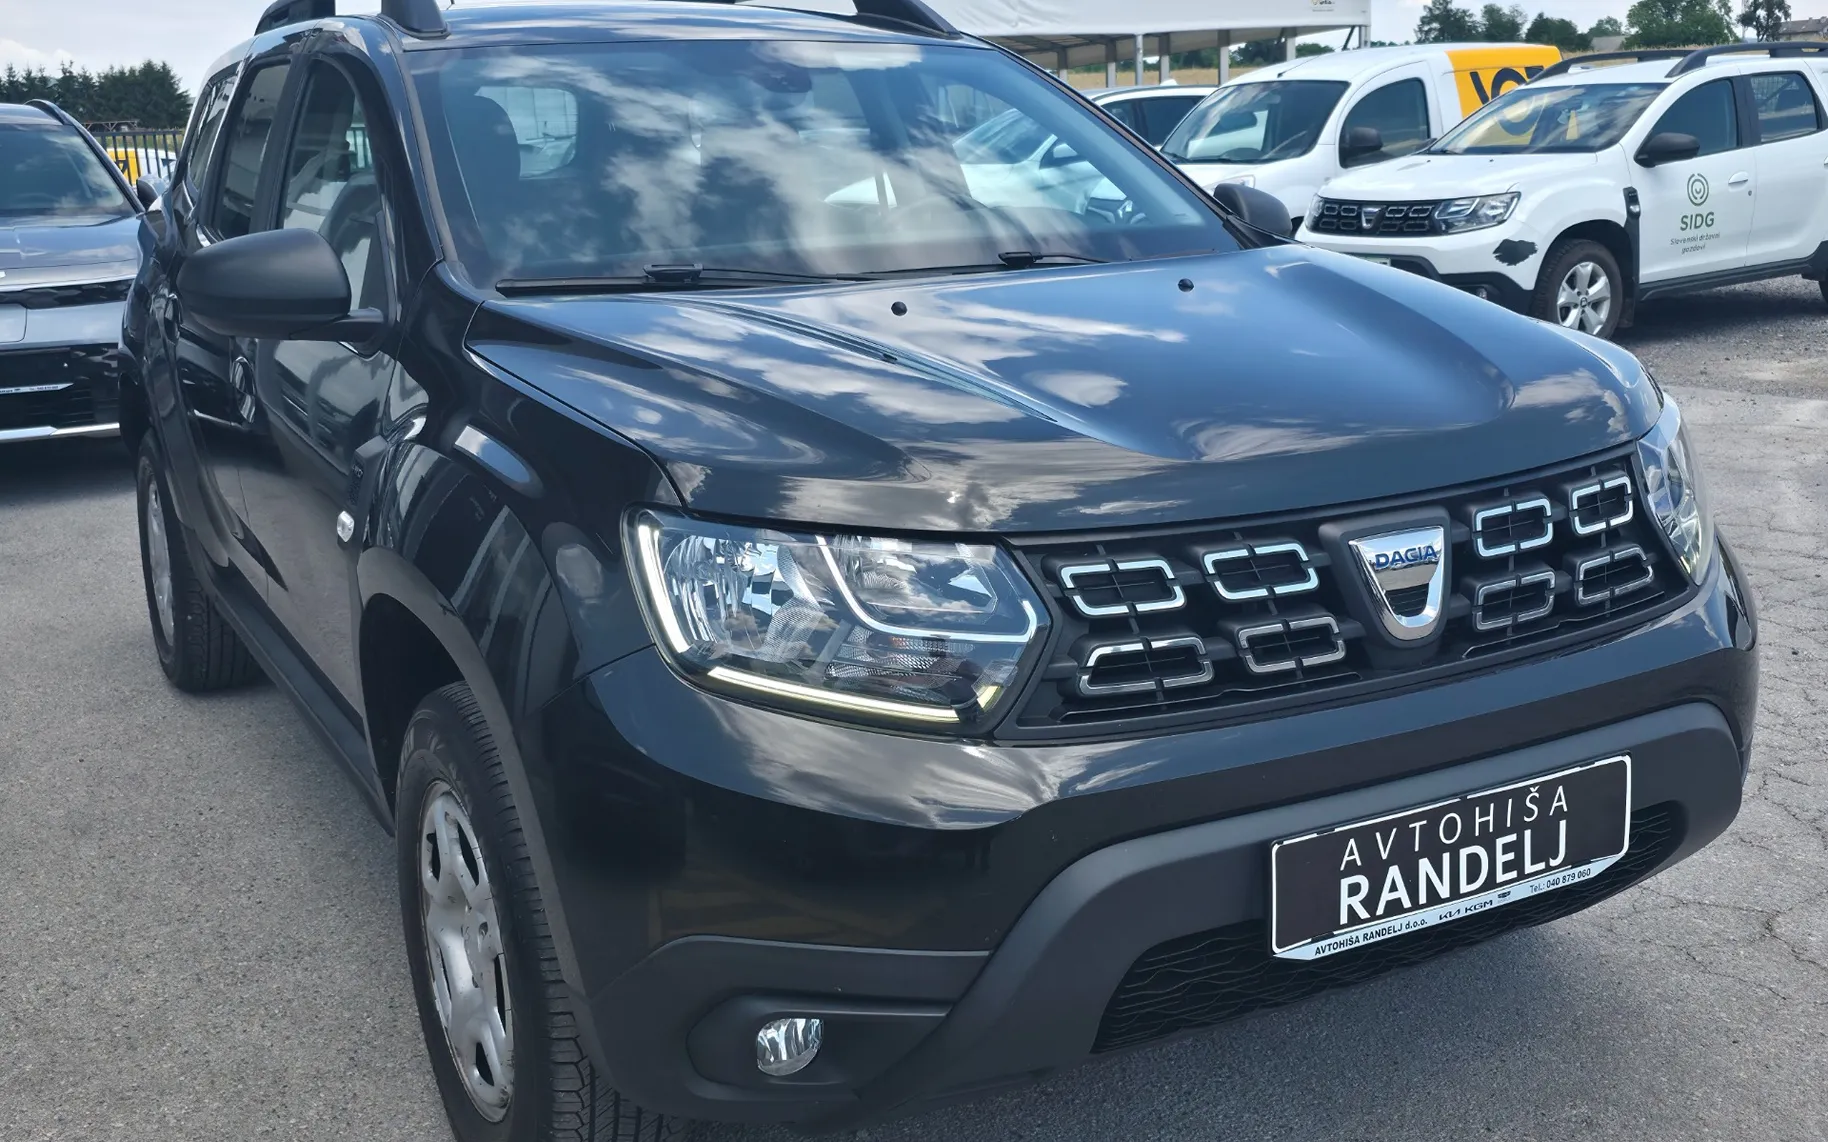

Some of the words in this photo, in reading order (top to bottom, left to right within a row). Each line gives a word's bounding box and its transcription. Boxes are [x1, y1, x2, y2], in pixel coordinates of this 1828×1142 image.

[1680, 211, 1714, 231] SIDG
[1670, 234, 1698, 245] Slovenski
[1681, 243, 1706, 254] gozdovi
[1375, 545, 1437, 568] DACIA
[1340, 785, 1568, 872] AVTOHIŠA
[1339, 819, 1567, 926] RANDELJ
[1314, 935, 1361, 956] AVTOHIŠA
[1362, 923, 1403, 942] RANDELJ
[1405, 918, 1428, 930] d.o.o.
[1464, 900, 1493, 914] KGM
[1546, 877, 1561, 889] 040
[1562, 873, 1577, 884] 879
[1577, 868, 1591, 879] 060
